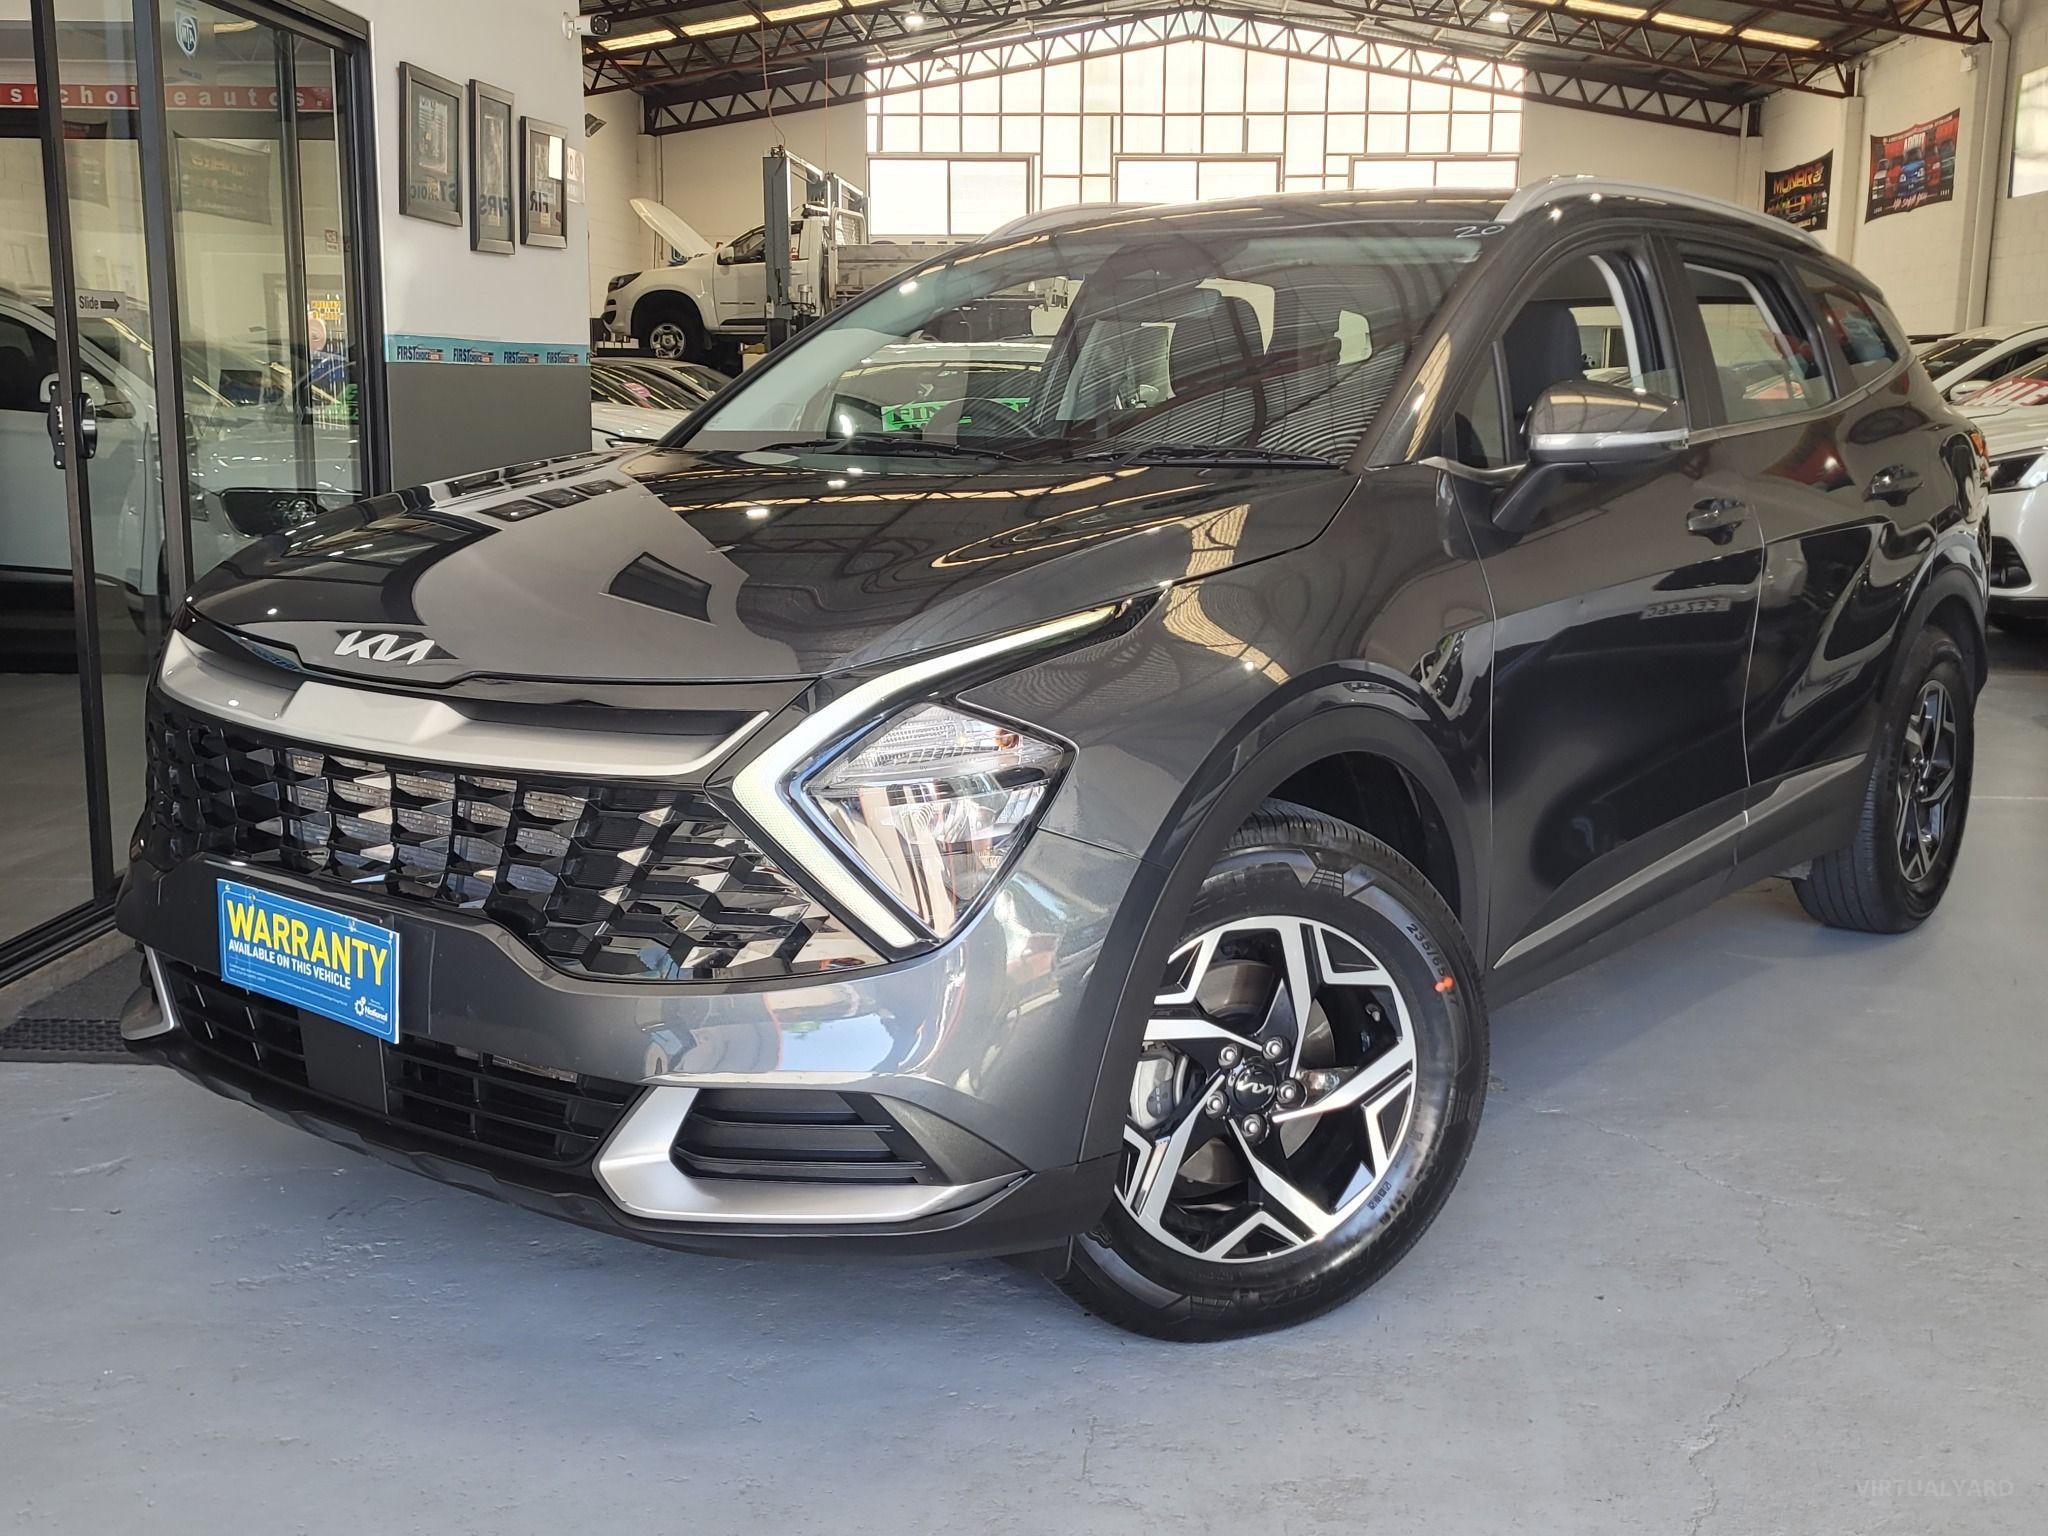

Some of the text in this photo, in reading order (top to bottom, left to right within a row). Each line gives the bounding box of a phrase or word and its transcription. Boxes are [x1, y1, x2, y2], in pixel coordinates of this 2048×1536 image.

[1454, 225, 1505, 238] 20
[79, 296, 99, 310] Slide
[334, 630, 435, 665] KIA
[226, 899, 388, 986] WARRANTY
[229, 939, 275, 964] AVAILABLE
[277, 953, 290, 969] ON
[291, 958, 312, 976] THIS
[313, 965, 351, 990] VEHICLE
